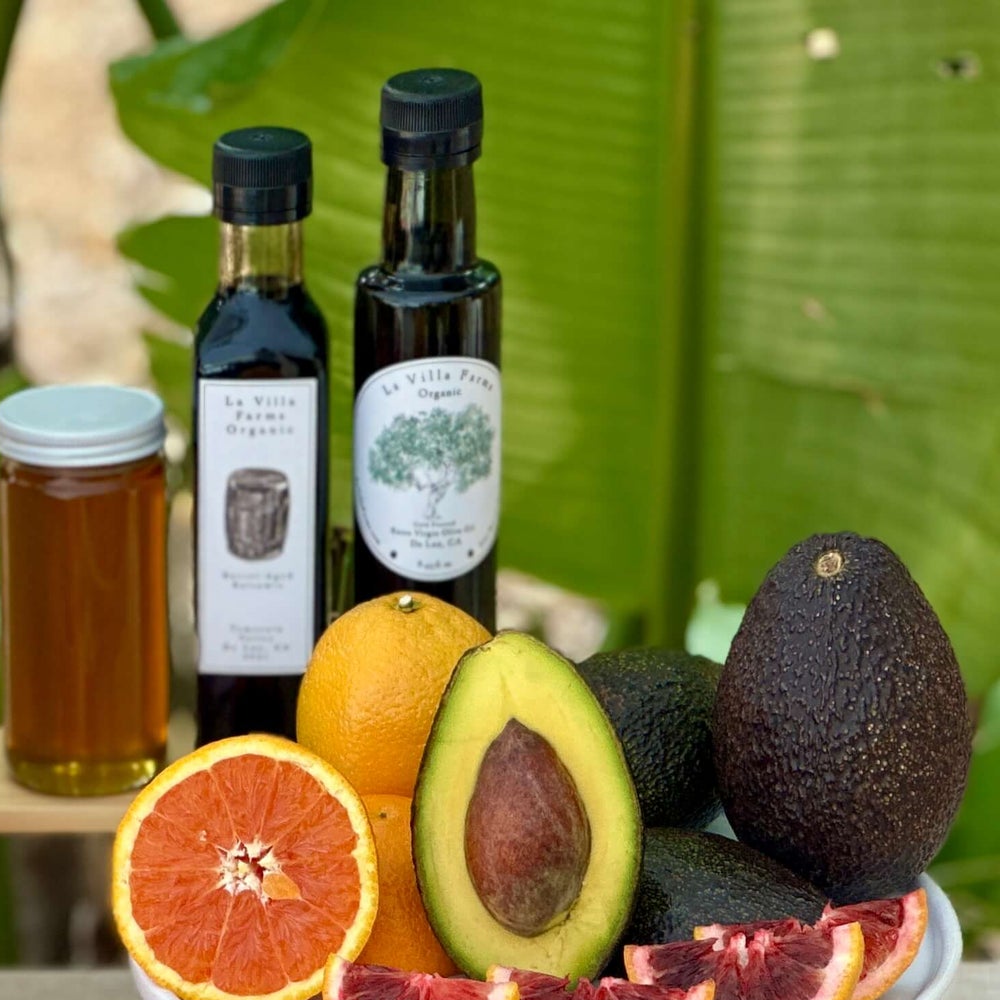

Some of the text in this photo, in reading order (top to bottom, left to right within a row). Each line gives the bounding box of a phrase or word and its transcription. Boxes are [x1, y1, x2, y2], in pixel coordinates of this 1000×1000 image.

[382, 384, 399, 396] La
[406, 368, 450, 384] Villa
[418, 388, 462, 400] Organic
[225, 395, 295, 407] La Villa
[236, 410, 284, 421] Farms
[226, 424, 294, 437] Organic
